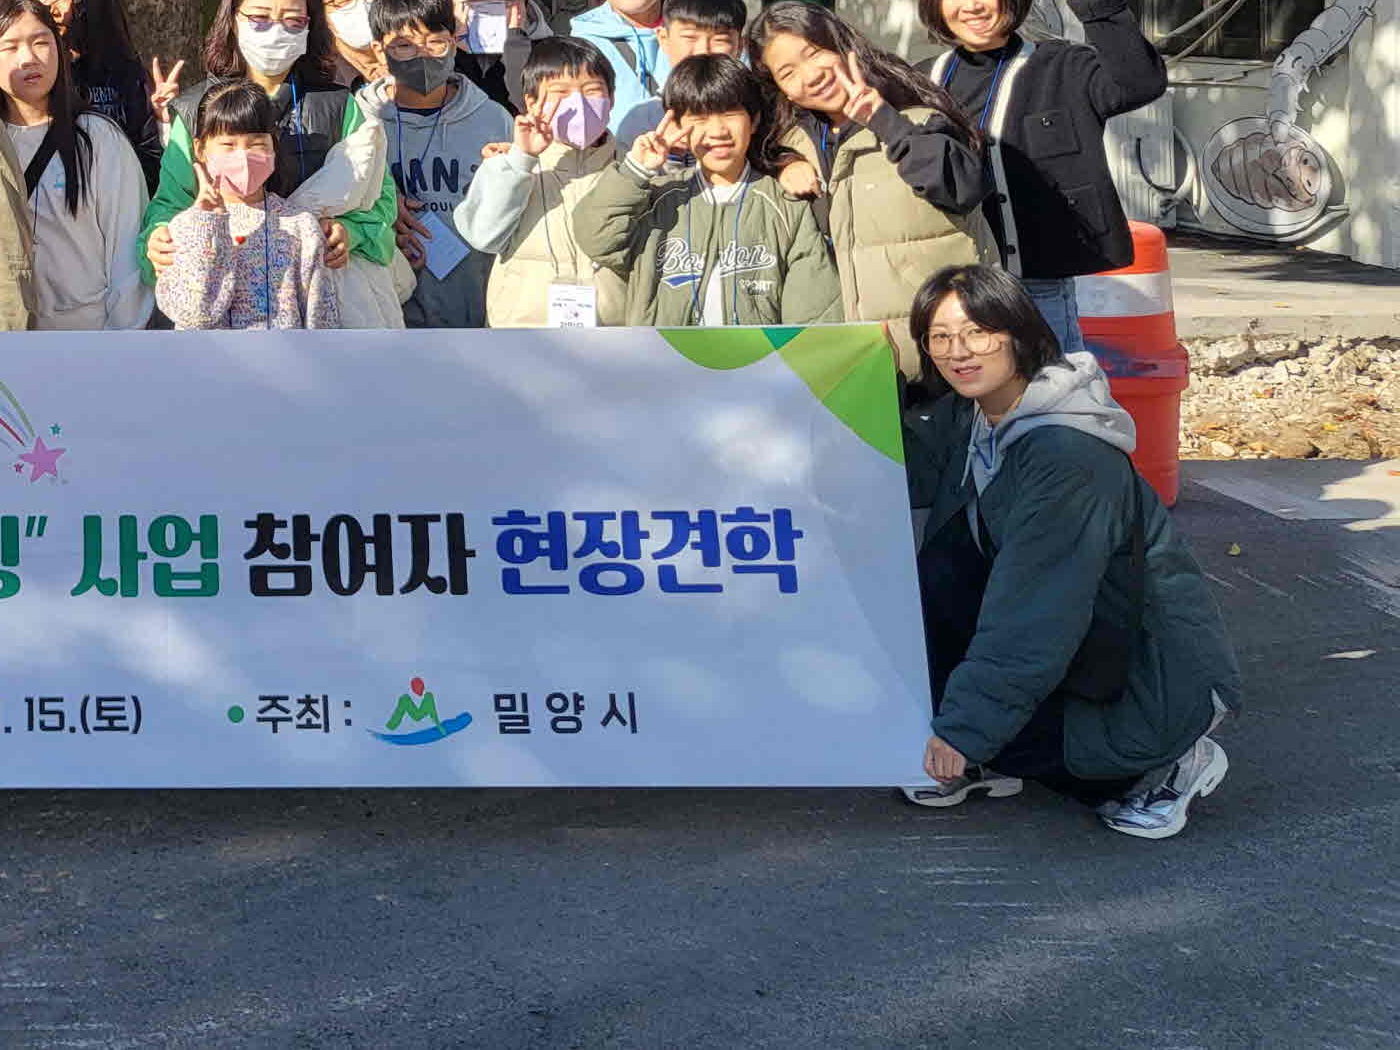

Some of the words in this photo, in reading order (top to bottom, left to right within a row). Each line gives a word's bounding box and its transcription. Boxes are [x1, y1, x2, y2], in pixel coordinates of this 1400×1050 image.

[70, 514, 220, 598] 사업
[242, 512, 477, 598] 참여자
[491, 506, 804, 596] 현장견학
